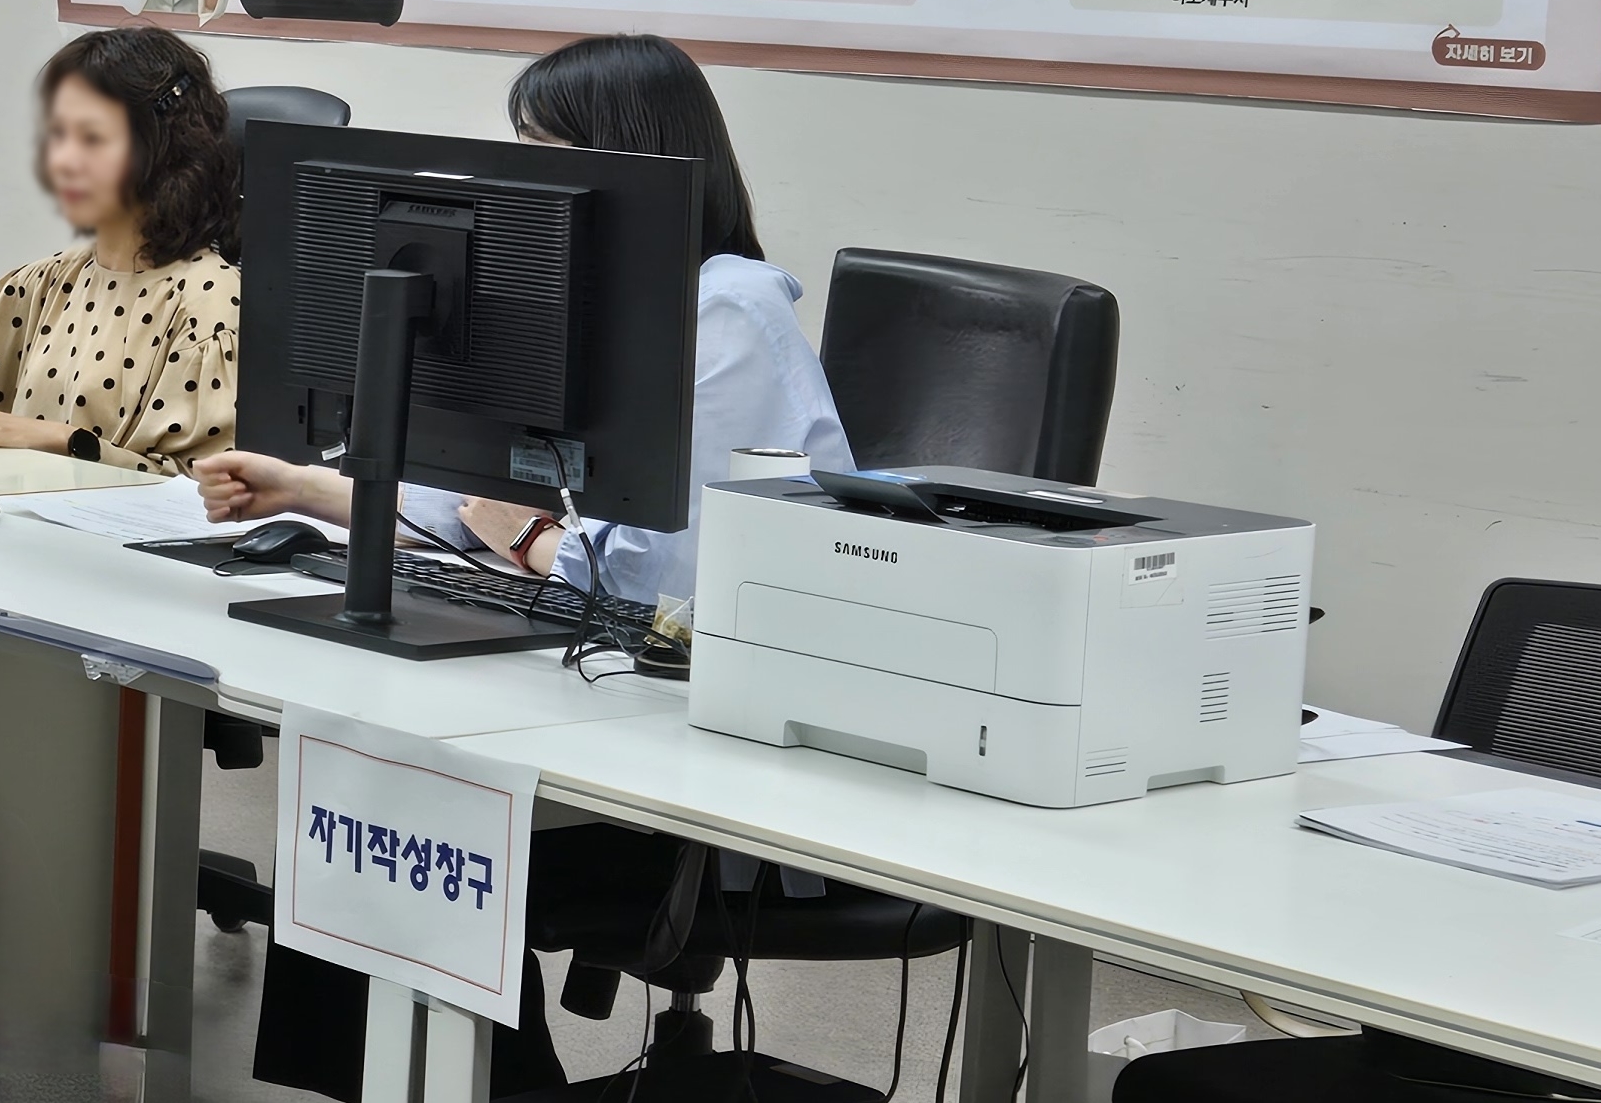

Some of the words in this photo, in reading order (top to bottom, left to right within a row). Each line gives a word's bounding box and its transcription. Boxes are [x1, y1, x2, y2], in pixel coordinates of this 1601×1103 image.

[1445, 43, 1494, 62] 자세히
[1499, 46, 1533, 64] 보기
[834, 541, 898, 564] SAMSUNG
[309, 805, 493, 910] 자기작성창구
